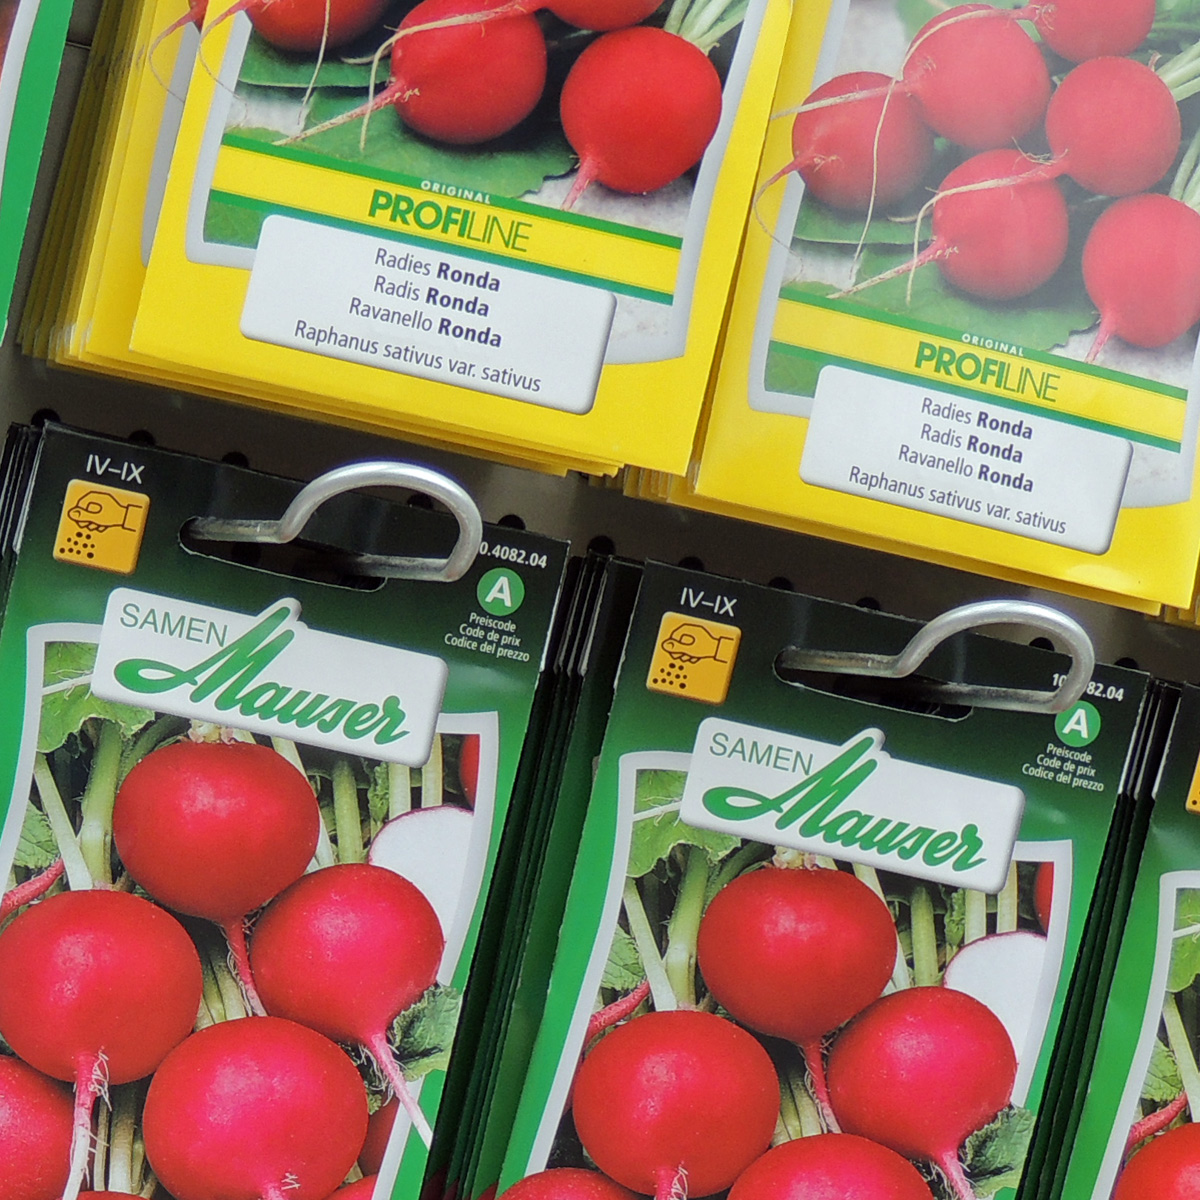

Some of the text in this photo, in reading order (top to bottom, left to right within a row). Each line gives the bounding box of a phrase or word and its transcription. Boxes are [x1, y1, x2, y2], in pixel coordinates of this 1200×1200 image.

[420, 179, 491, 204] ORIGINAL
[367, 189, 533, 253] PROFILINE
[374, 247, 500, 292] Radies Ronda
[373, 274, 489, 317] Radis Ronda
[348, 296, 502, 348] Ravanello Ronda
[294, 319, 541, 392] Raphanus sativus var. sativus
[961, 333, 1025, 357] ORIGINAL
[914, 341, 1060, 403] PROFILINE
[920, 396, 1033, 440] Radies Ronda
[898, 443, 1034, 493] Ravanello Ronda
[479, 541, 547, 569] 0.4082.04
[485, 576, 512, 607] A
[119, 602, 229, 648] SAMEN
[113, 605, 411, 746] Mauser
[1062, 708, 1089, 738] A
[709, 732, 814, 776] SAMEN
[702, 735, 988, 871] Mauser
